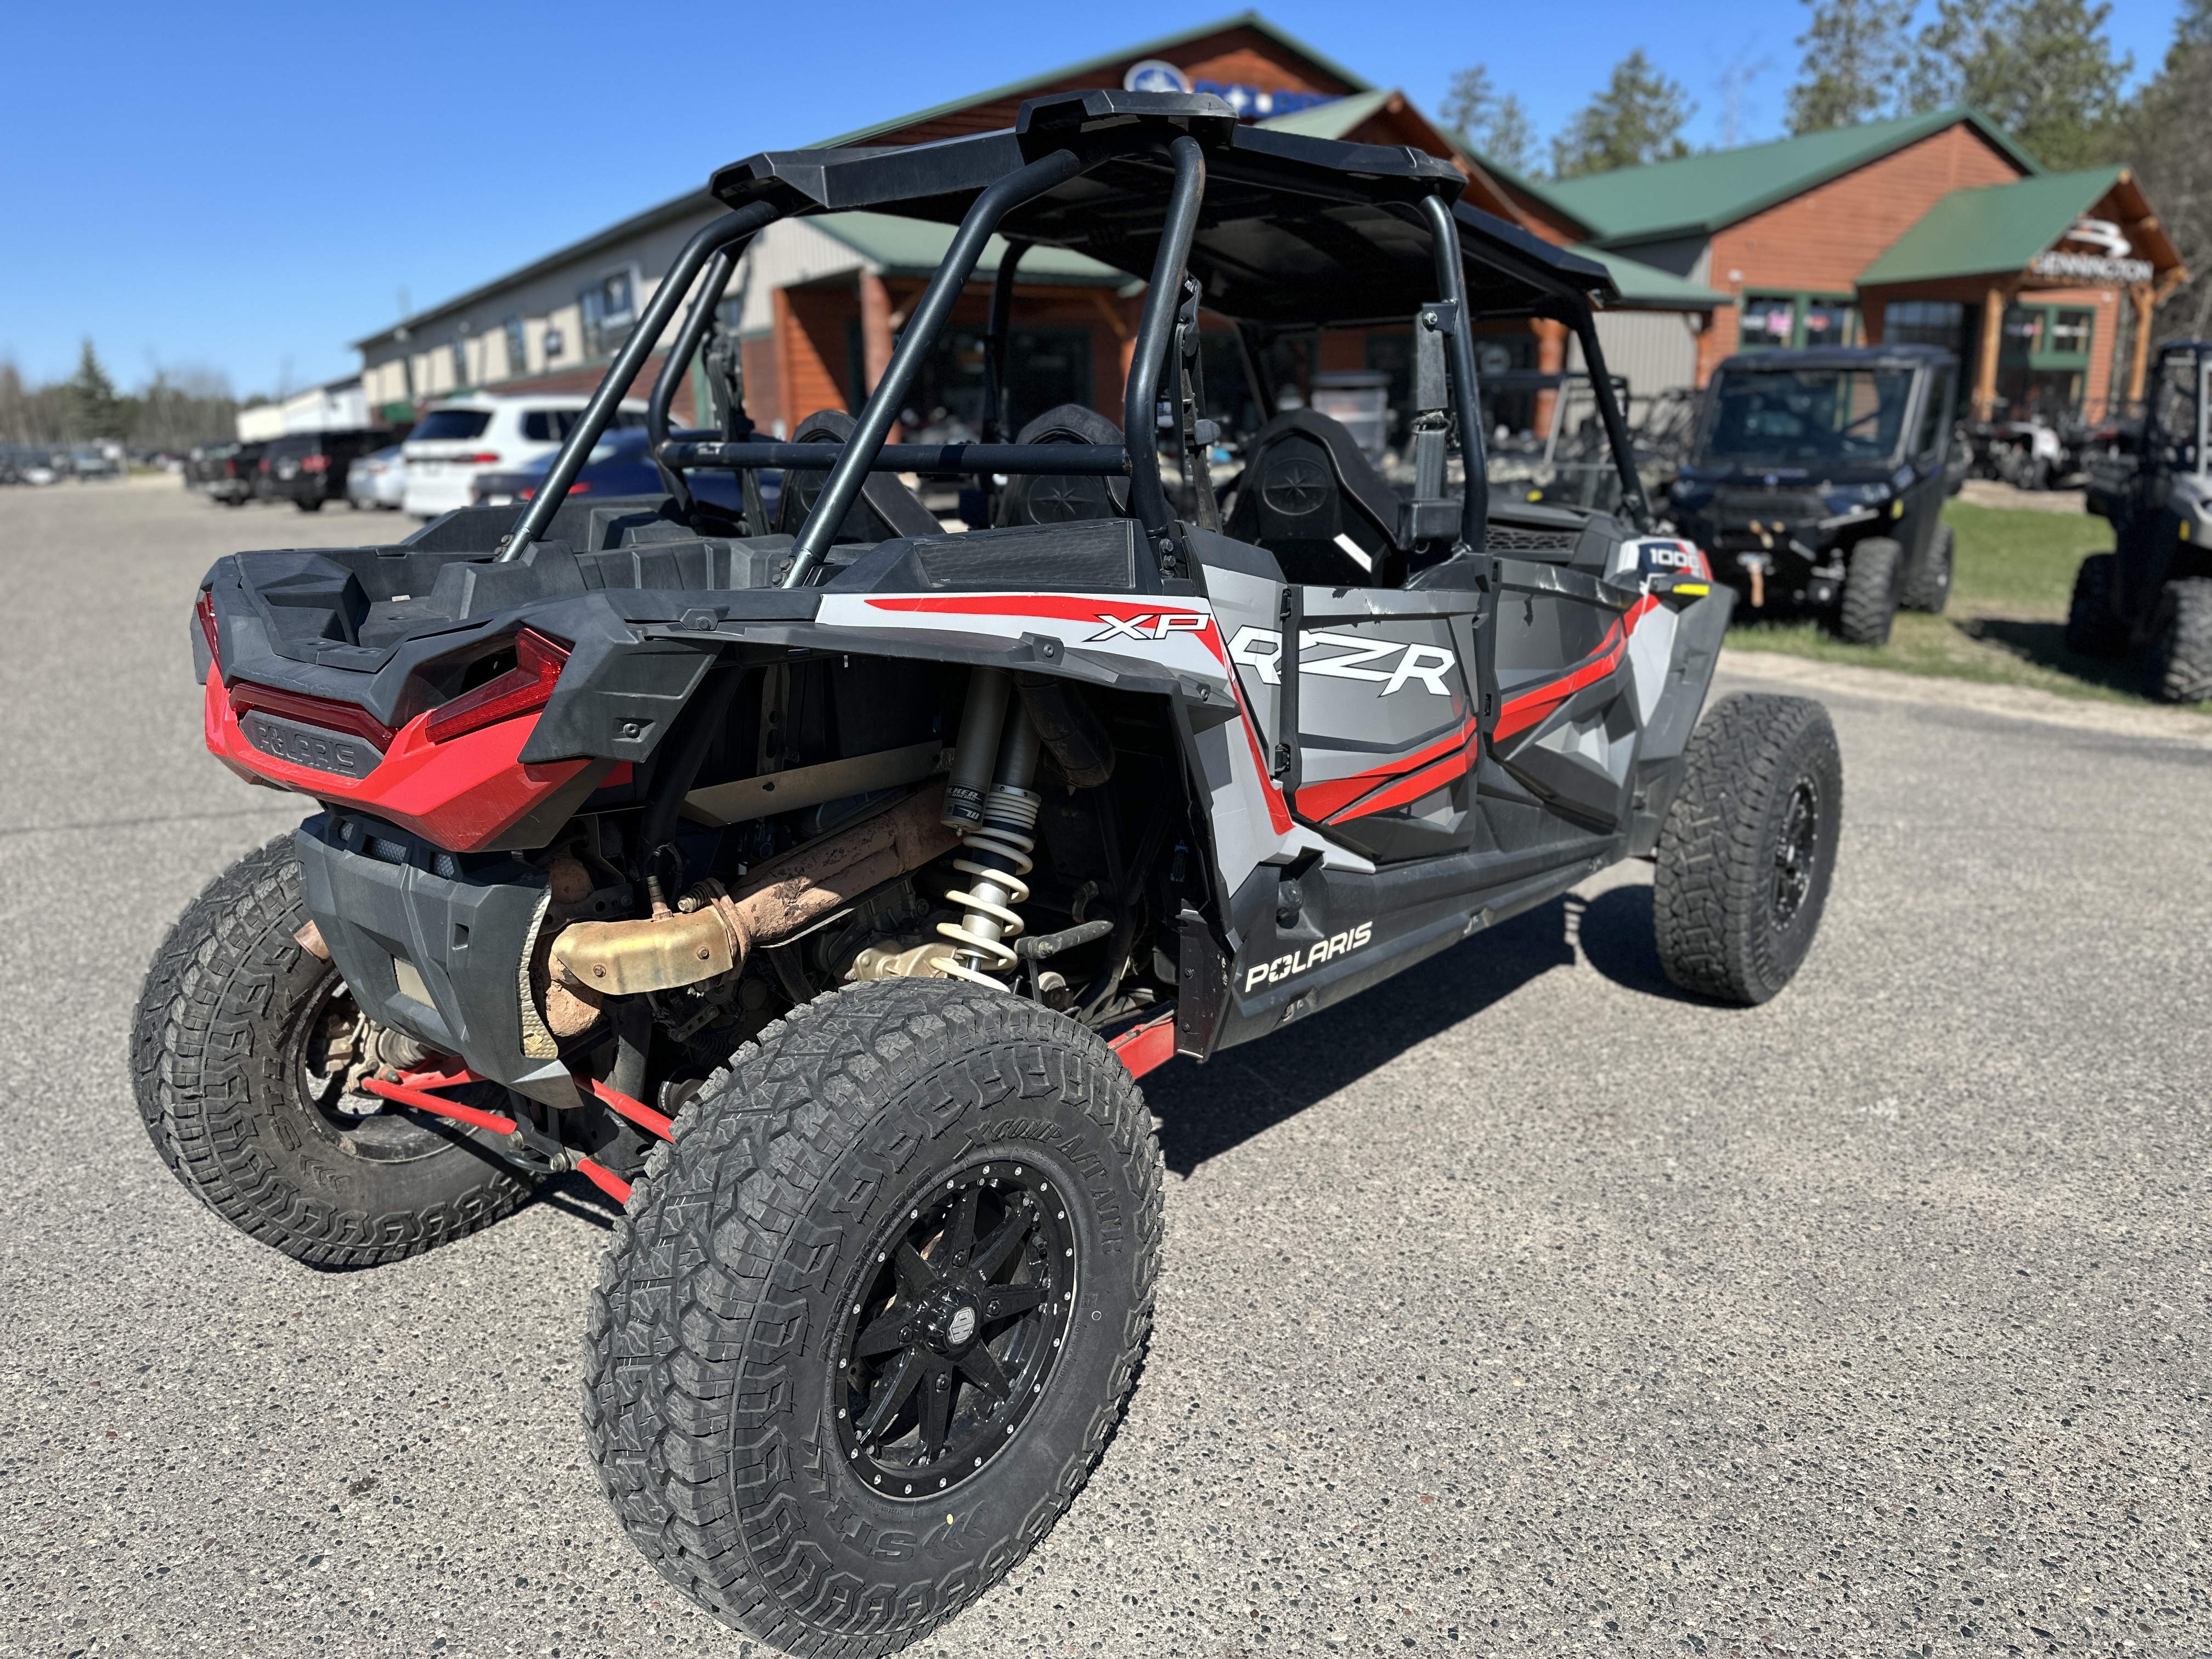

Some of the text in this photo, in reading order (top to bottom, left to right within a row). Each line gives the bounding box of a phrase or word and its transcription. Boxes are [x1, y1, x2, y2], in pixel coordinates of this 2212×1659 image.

[1082, 613, 1210, 642] XP
[1227, 624, 1455, 697] RZR
[255, 720, 357, 776] POLARIS
[947, 787, 983, 801] LKER
[1244, 921, 1373, 993] POLARIS
[1073, 1320, 1082, 1337] DOT
[824, 1495, 918, 1563] STI
